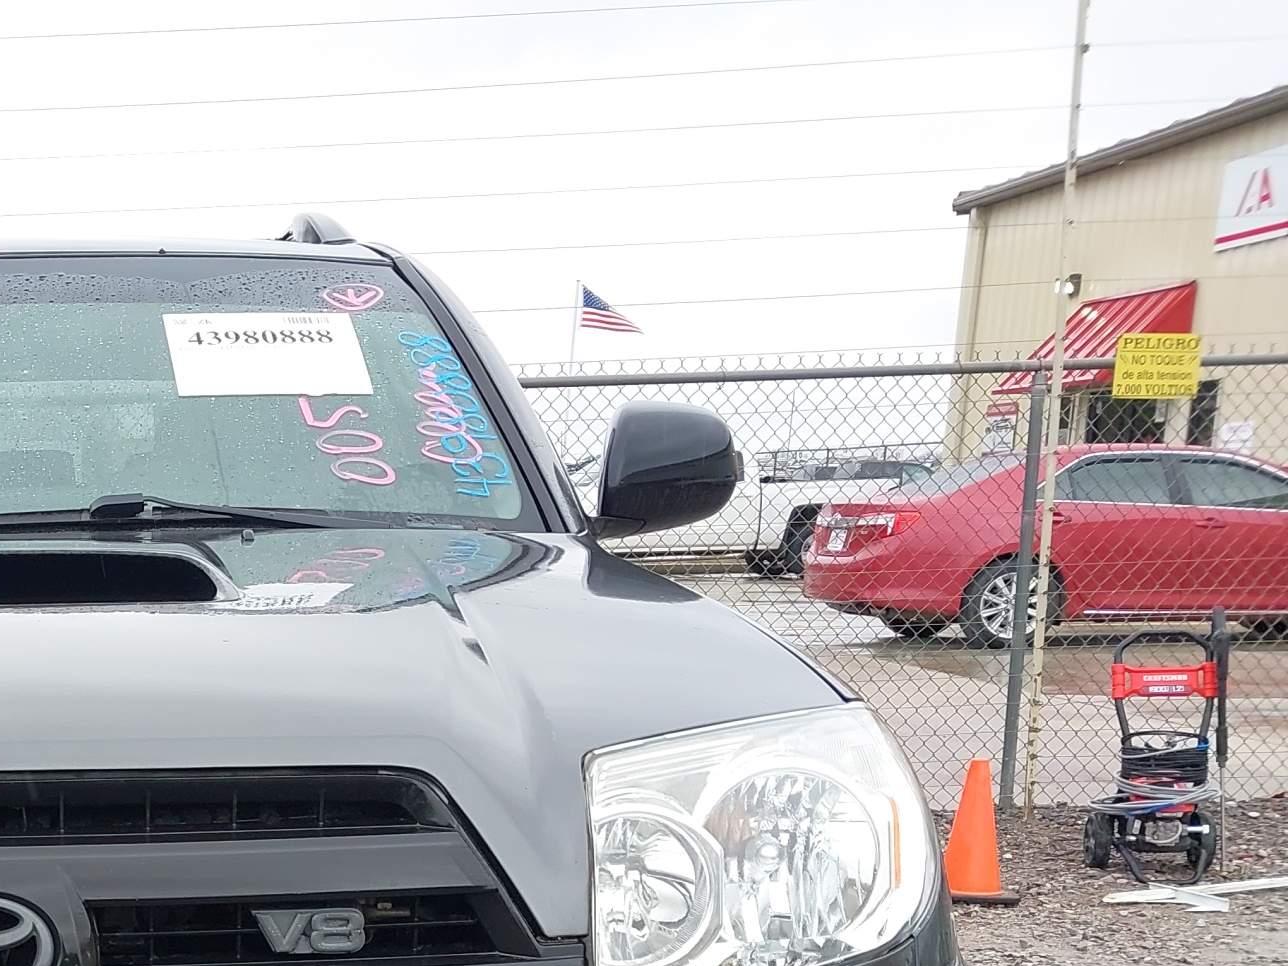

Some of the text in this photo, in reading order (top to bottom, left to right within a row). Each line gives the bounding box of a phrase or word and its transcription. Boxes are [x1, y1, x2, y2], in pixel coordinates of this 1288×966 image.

[187, 330, 333, 345] 43980888
[1122, 337, 1200, 350] PELIGRO
[1132, 354, 1185, 365] NO TOQUE
[1122, 370, 1134, 380] de
[250, 908, 367, 955] V8
